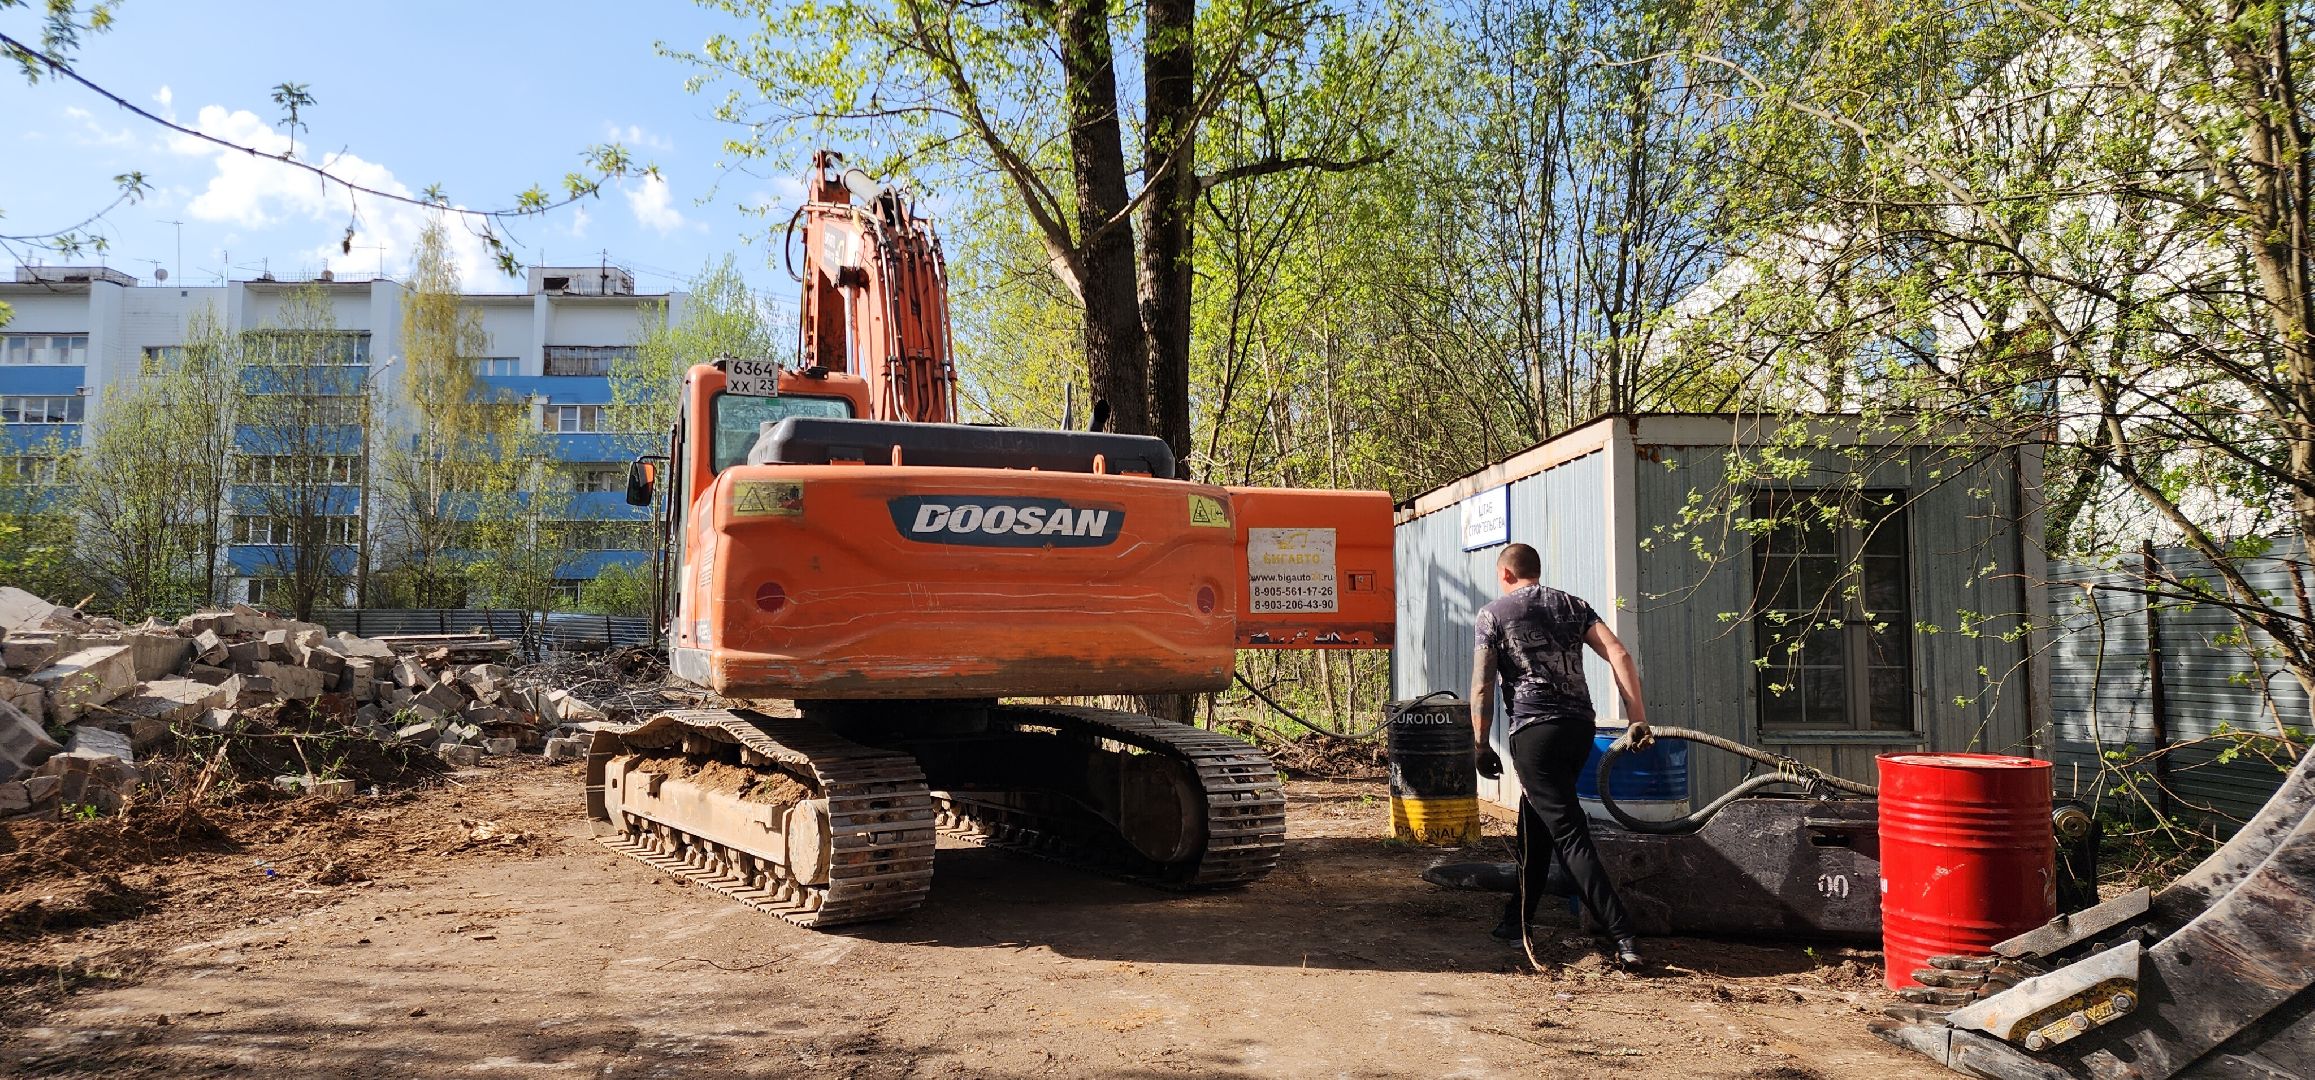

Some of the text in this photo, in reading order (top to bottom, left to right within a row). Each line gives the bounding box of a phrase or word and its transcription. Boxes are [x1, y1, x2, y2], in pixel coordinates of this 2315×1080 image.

[733, 361, 773, 377] 6364
[759, 380, 775, 391] 23
[911, 504, 1109, 537] DOOSAN
[1254, 586, 1333, 597] 8-905-561-17-26
[1254, 600, 1334, 610] 8-903-206-43-90
[1396, 825, 1456, 839] ORIGNAL
